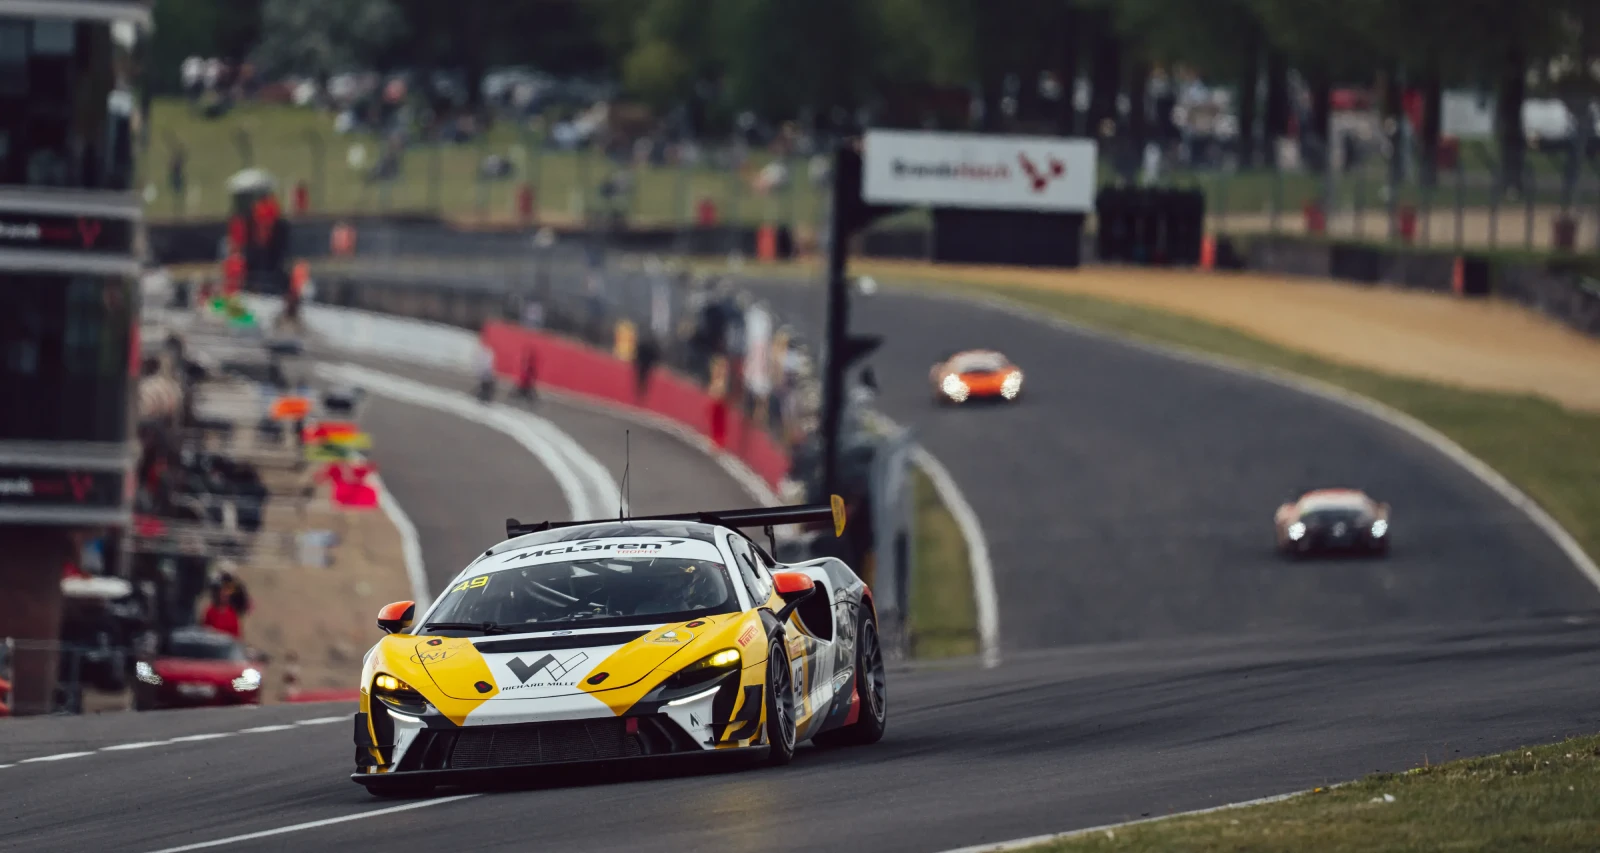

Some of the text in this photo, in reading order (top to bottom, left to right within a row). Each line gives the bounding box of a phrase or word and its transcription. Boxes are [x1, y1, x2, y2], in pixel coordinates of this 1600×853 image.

[502, 542, 662, 564] McLaren
[451, 576, 489, 593] 49
[502, 683, 544, 691] RICHARD
